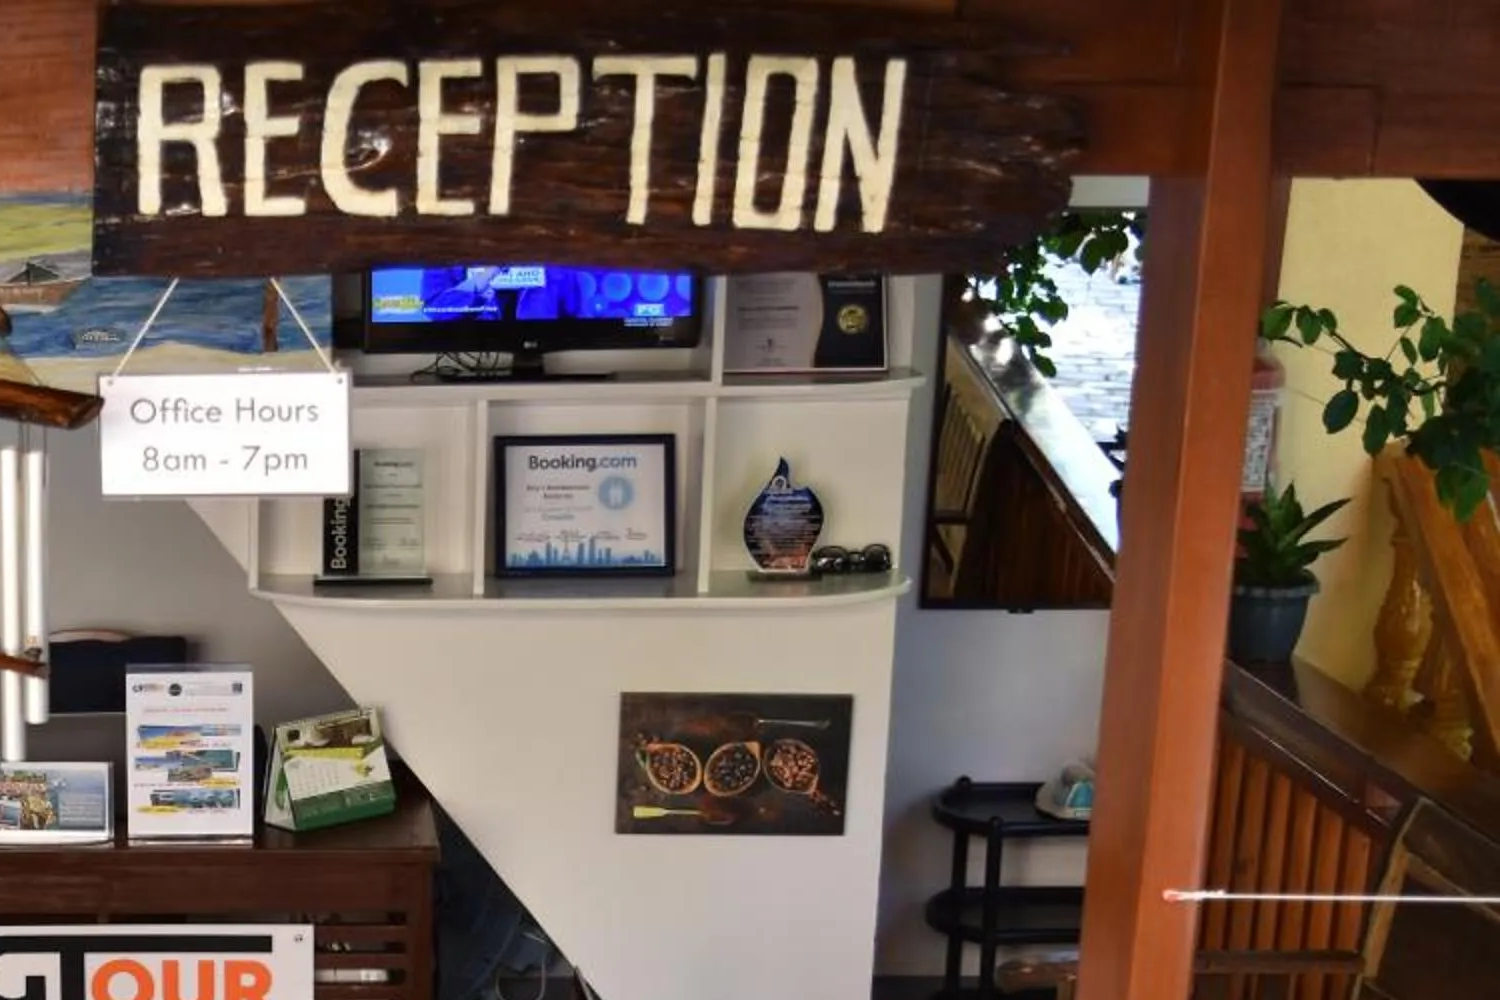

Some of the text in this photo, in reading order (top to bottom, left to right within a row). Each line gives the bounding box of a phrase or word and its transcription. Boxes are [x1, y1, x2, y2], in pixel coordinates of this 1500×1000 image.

[137, 53, 906, 233] RECEPTION
[130, 397, 320, 425] Office Hours
[142, 446, 207, 472] 8am
[242, 445, 308, 477] 7pm
[528, 455, 638, 472] Booking.com
